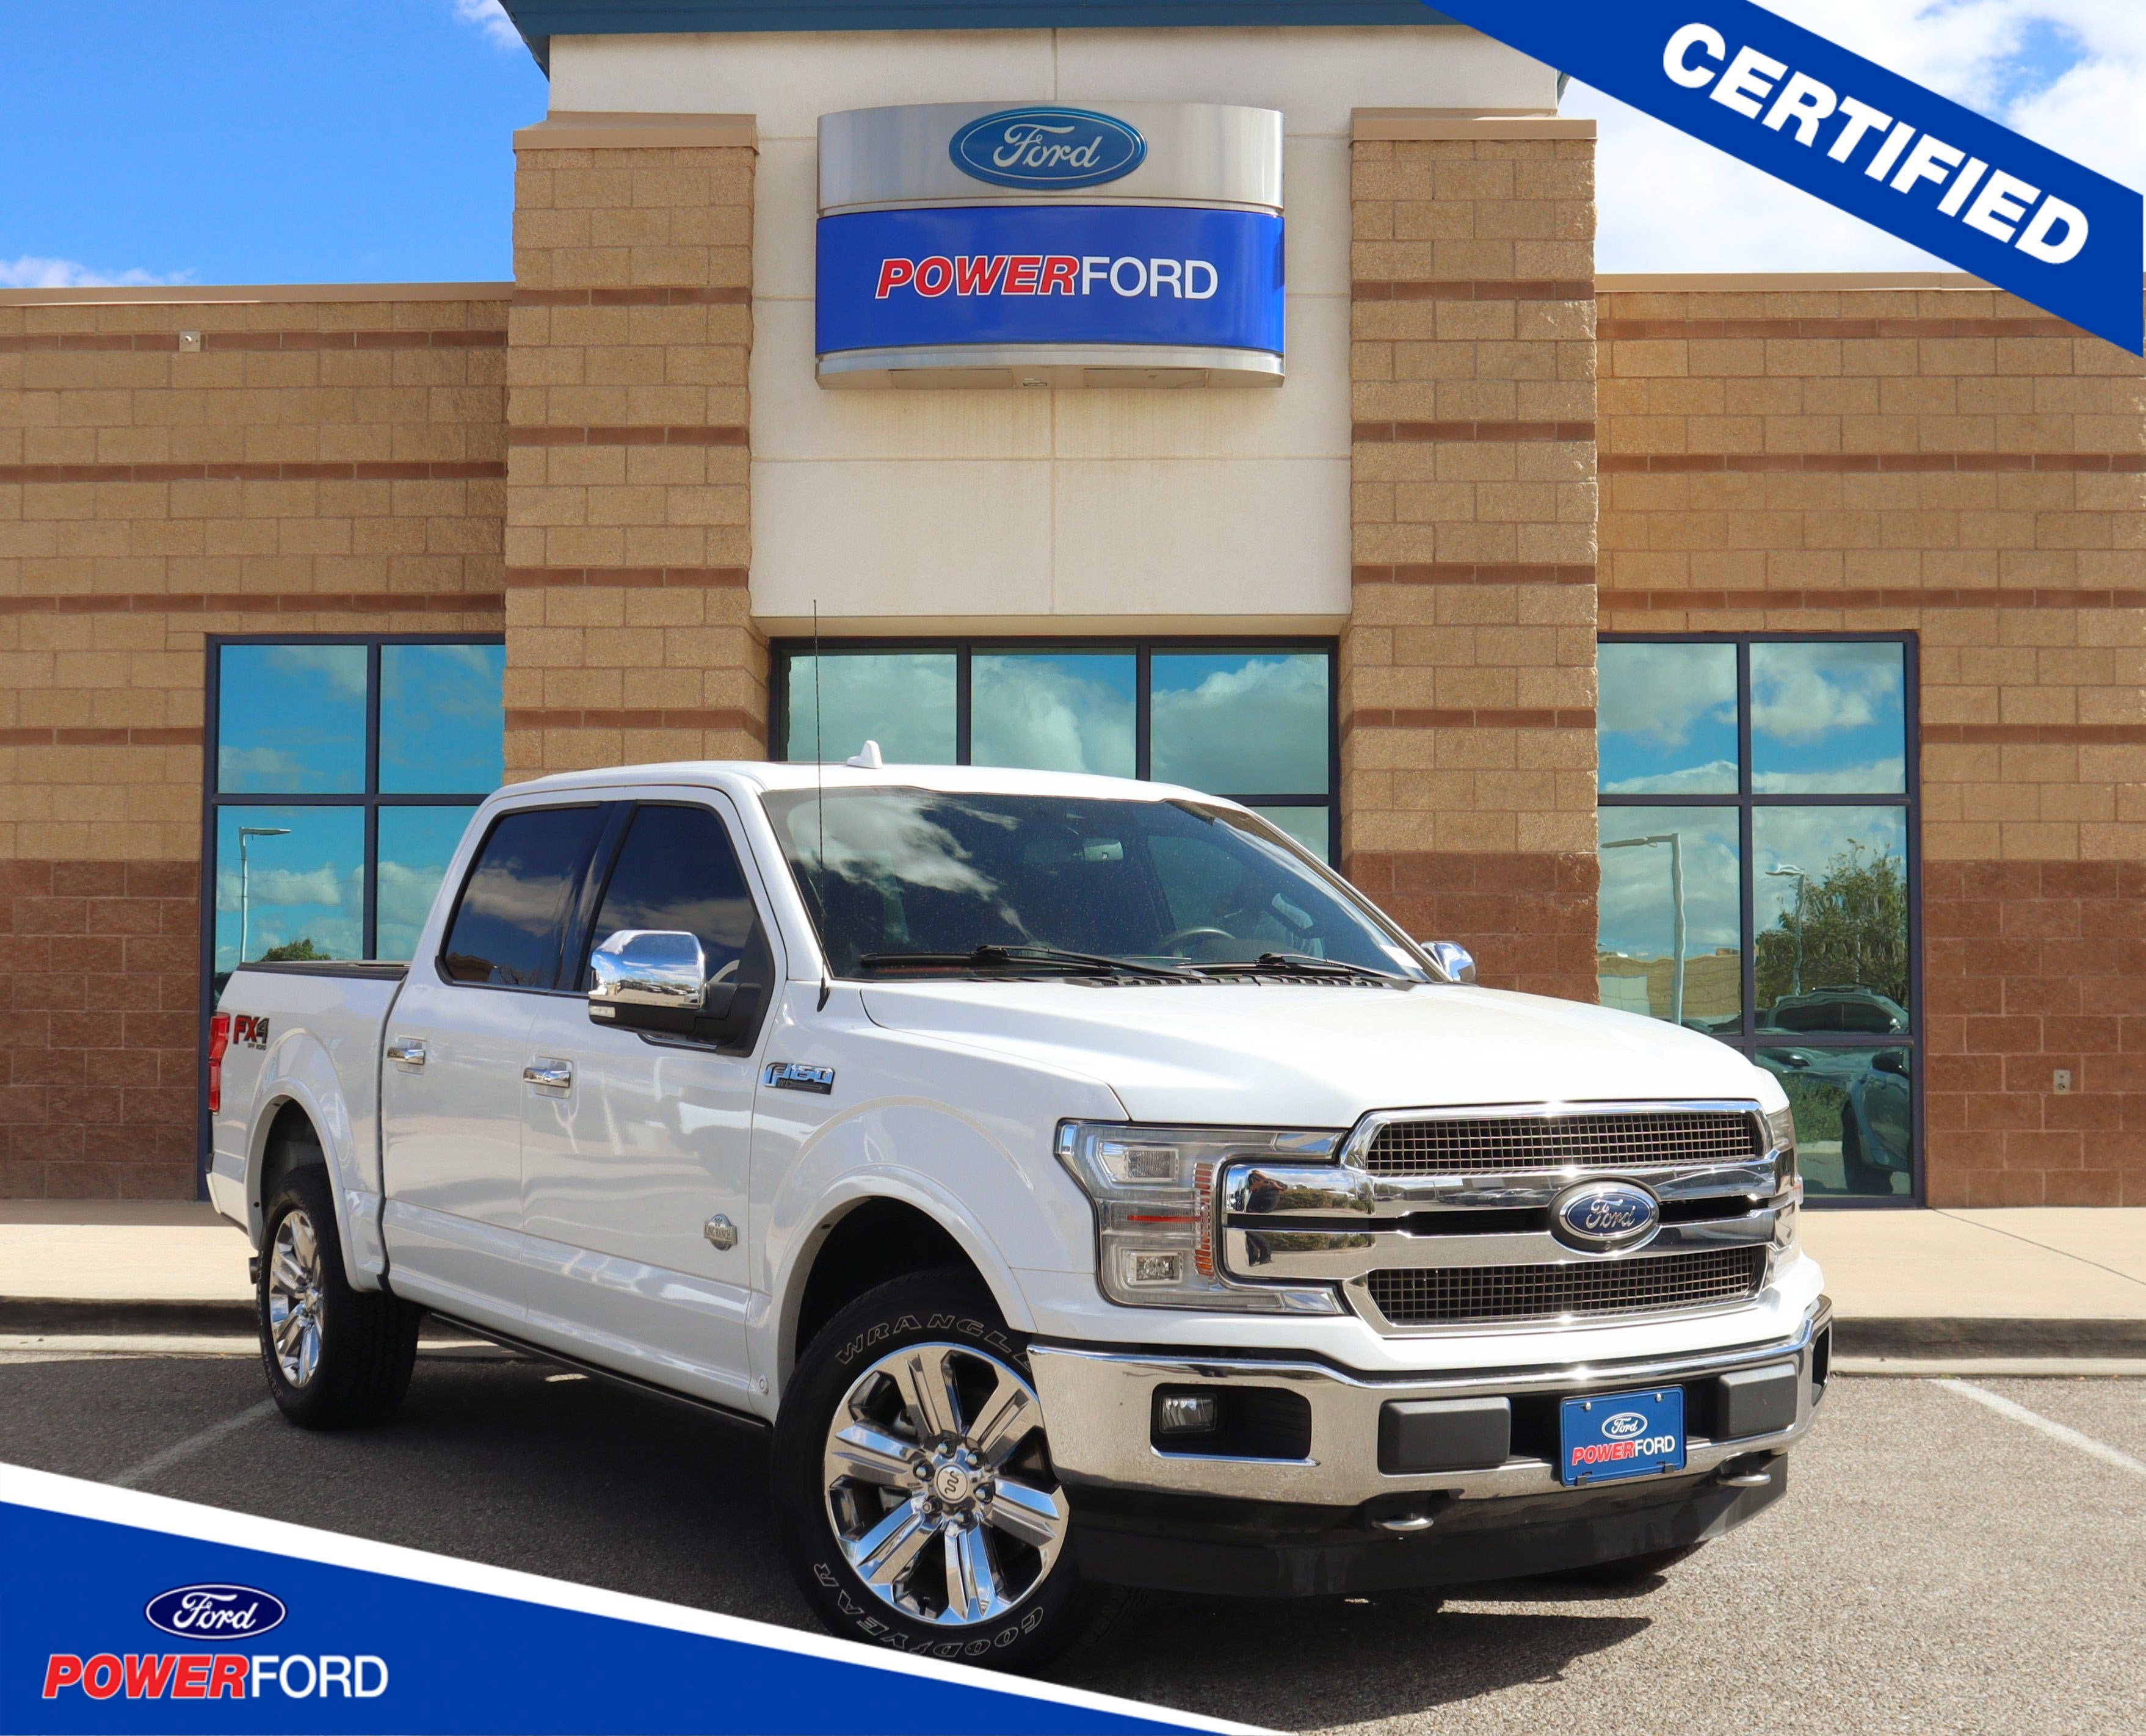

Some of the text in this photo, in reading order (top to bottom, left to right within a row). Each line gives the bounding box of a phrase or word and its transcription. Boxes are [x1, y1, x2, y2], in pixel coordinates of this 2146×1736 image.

[992, 122, 1103, 168] Ford
[874, 255, 1219, 299] POWERFORD
[233, 1014, 270, 1045] FX4
[1585, 1199, 1636, 1230] Ford
[1611, 1417, 1639, 1434] Ford
[1571, 1435, 1676, 1466] POWERFORD
[813, 1562, 1044, 1657] GOODYEAR
